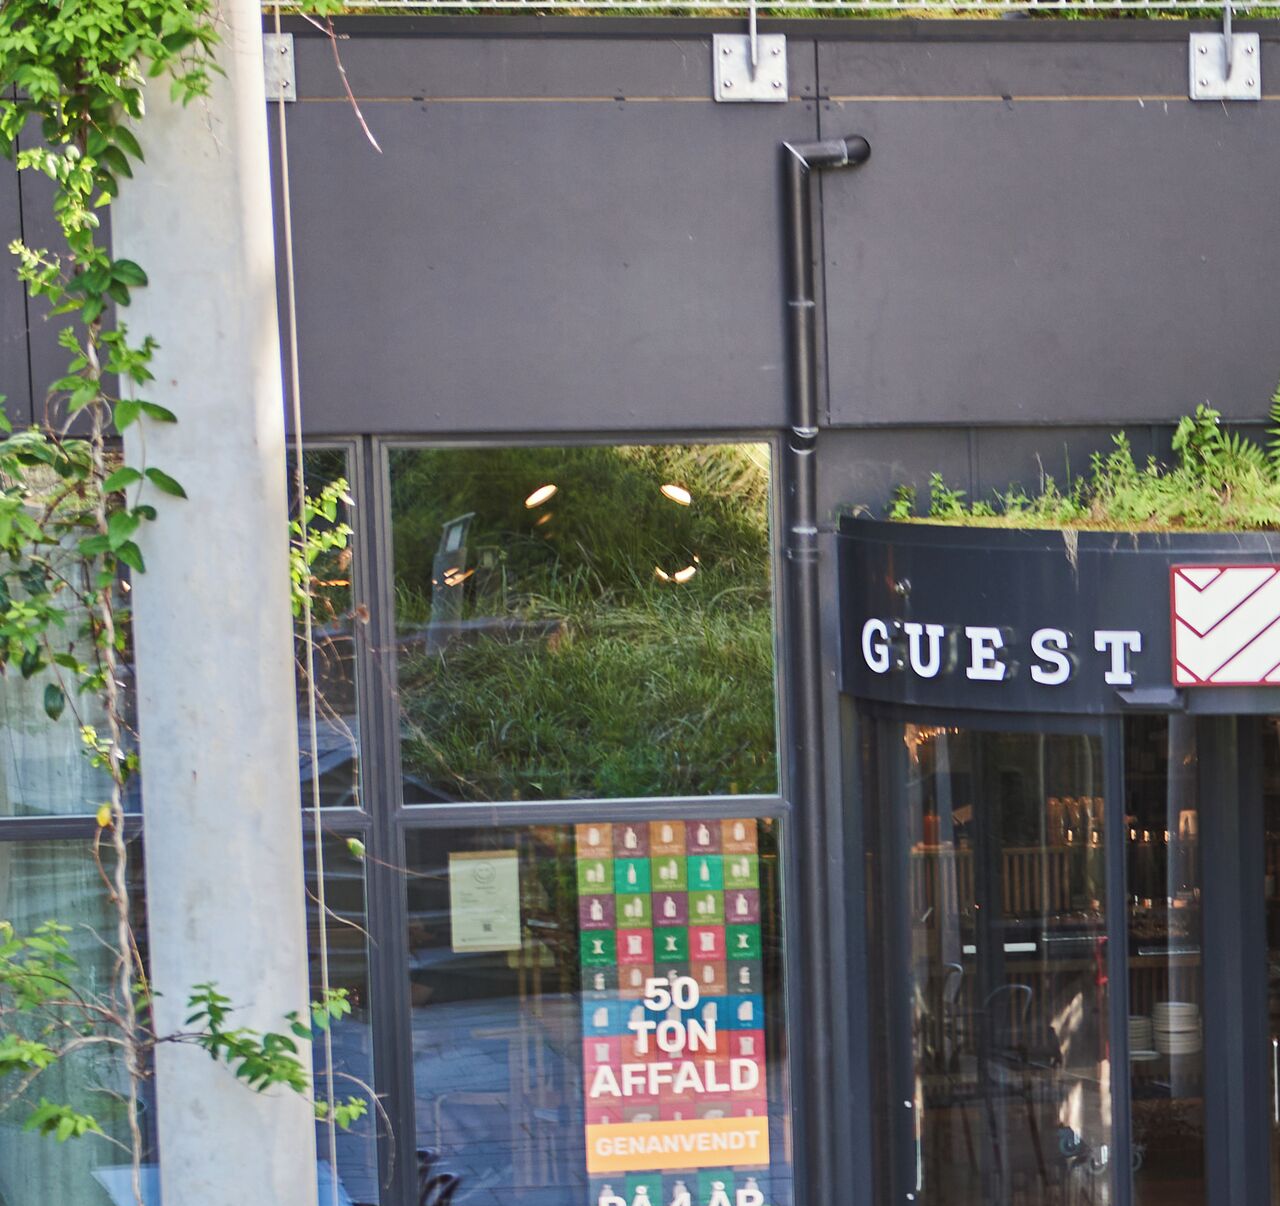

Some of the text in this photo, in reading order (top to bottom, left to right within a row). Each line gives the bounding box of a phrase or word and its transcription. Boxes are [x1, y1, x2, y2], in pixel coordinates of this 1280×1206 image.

[861, 617, 1142, 686] GUEST
[643, 976, 700, 1010] 50
[628, 1018, 717, 1054] TON
[590, 1058, 759, 1098] AFFALD
[596, 1130, 760, 1156] GENANVENDT
